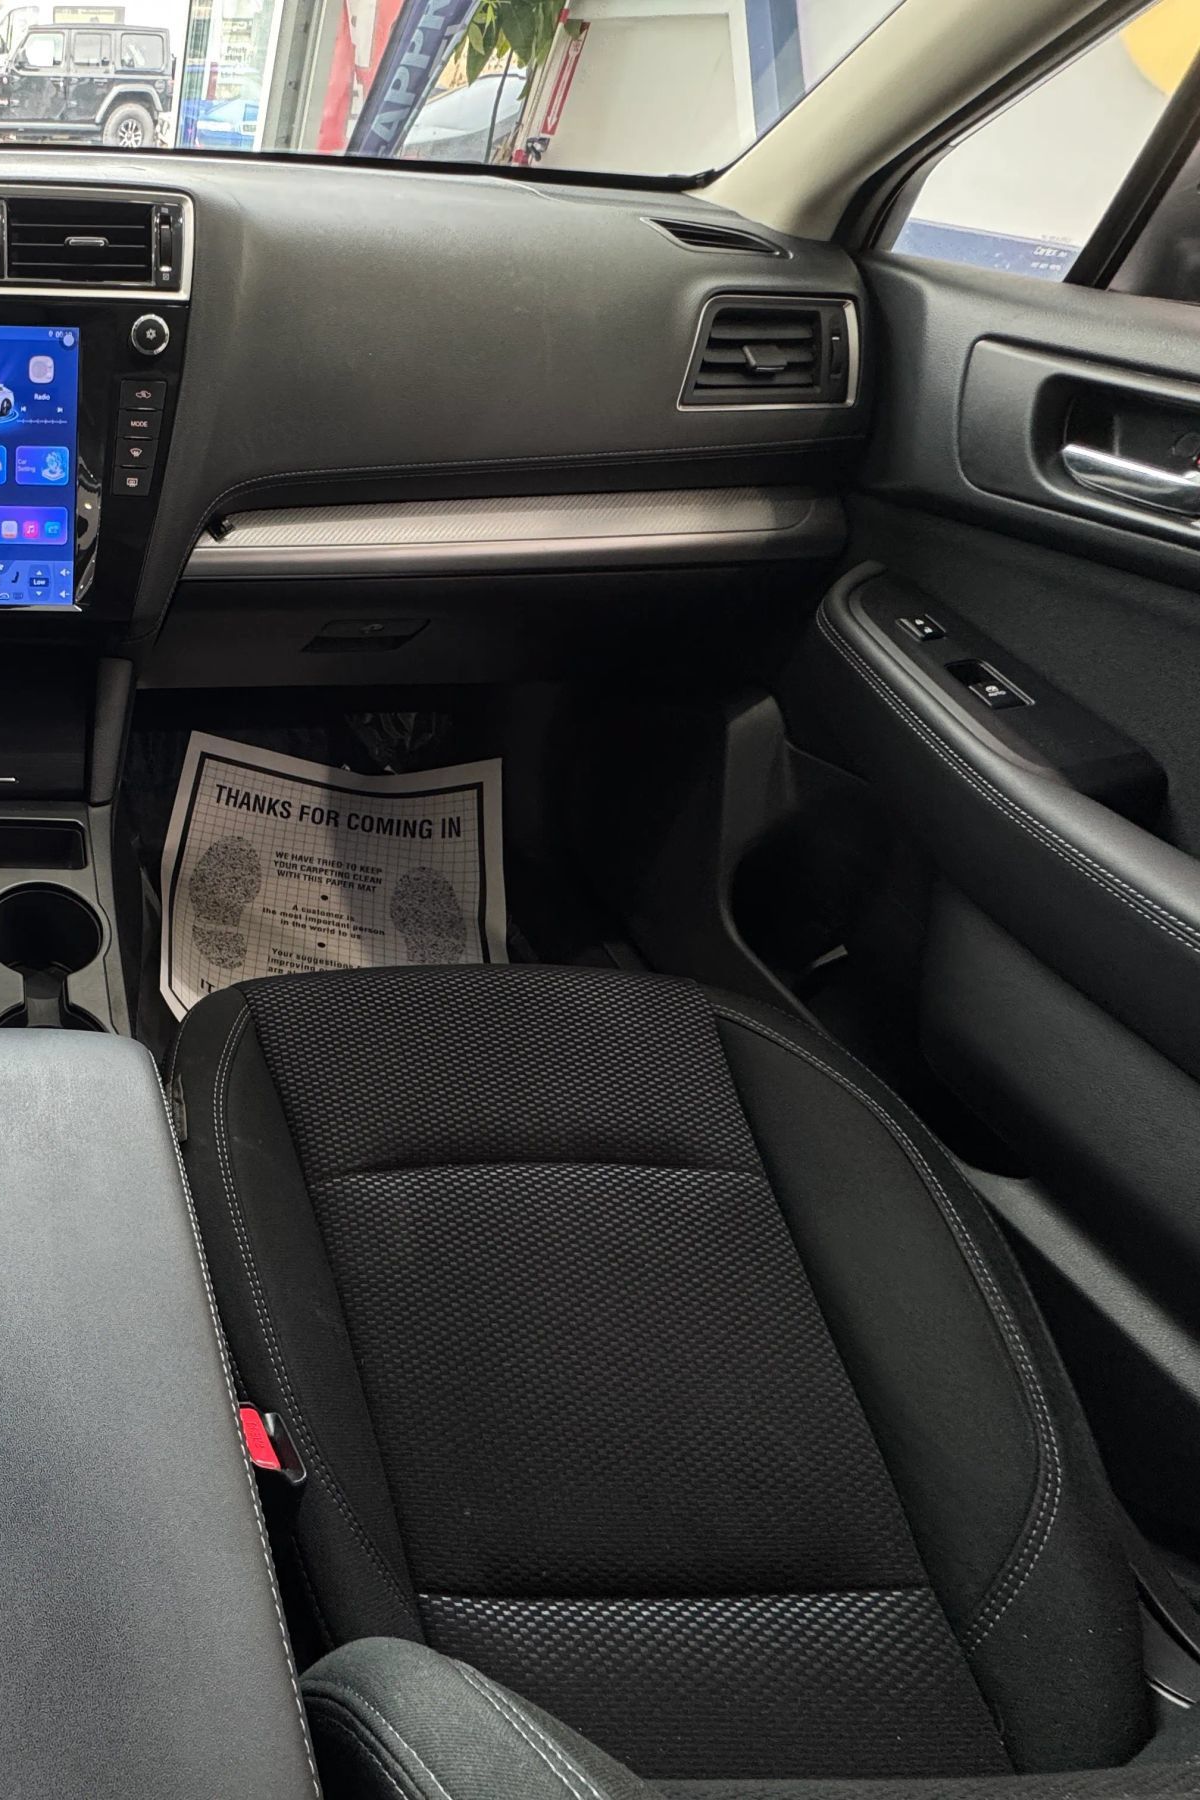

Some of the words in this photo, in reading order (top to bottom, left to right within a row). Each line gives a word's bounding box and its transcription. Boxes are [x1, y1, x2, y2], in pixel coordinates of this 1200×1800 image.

[34, 393, 51, 401] Radio
[130, 420, 148, 428] MODE
[216, 784, 292, 819] THANKS
[299, 804, 340, 828] FOR
[347, 812, 432, 839] COMING
[441, 816, 462, 838] IN
[276, 851, 288, 860] WE
[291, 854, 314, 864] HAVE
[317, 858, 343, 868] TRIED
[346, 862, 356, 871] TO
[360, 864, 382, 874] KEEP
[274, 860, 298, 870] YOUR
[300, 864, 350, 879] CARPETING
[352, 874, 382, 884] CLEAN
[277, 870, 300, 880] WITH
[303, 874, 322, 884] THIS
[326, 878, 354, 890] PAPER
[358, 882, 376, 892] MAT
[302, 906, 344, 920] customer
[262, 908, 276, 916] the
[280, 910, 302, 920] most
[306, 912, 350, 930] important
[352, 924, 385, 936] person
[292, 921, 306, 929] the
[310, 924, 335, 935] world
[272, 948, 294, 958] Your
[268, 966, 284, 974] are
[200, 978, 216, 994] IT
